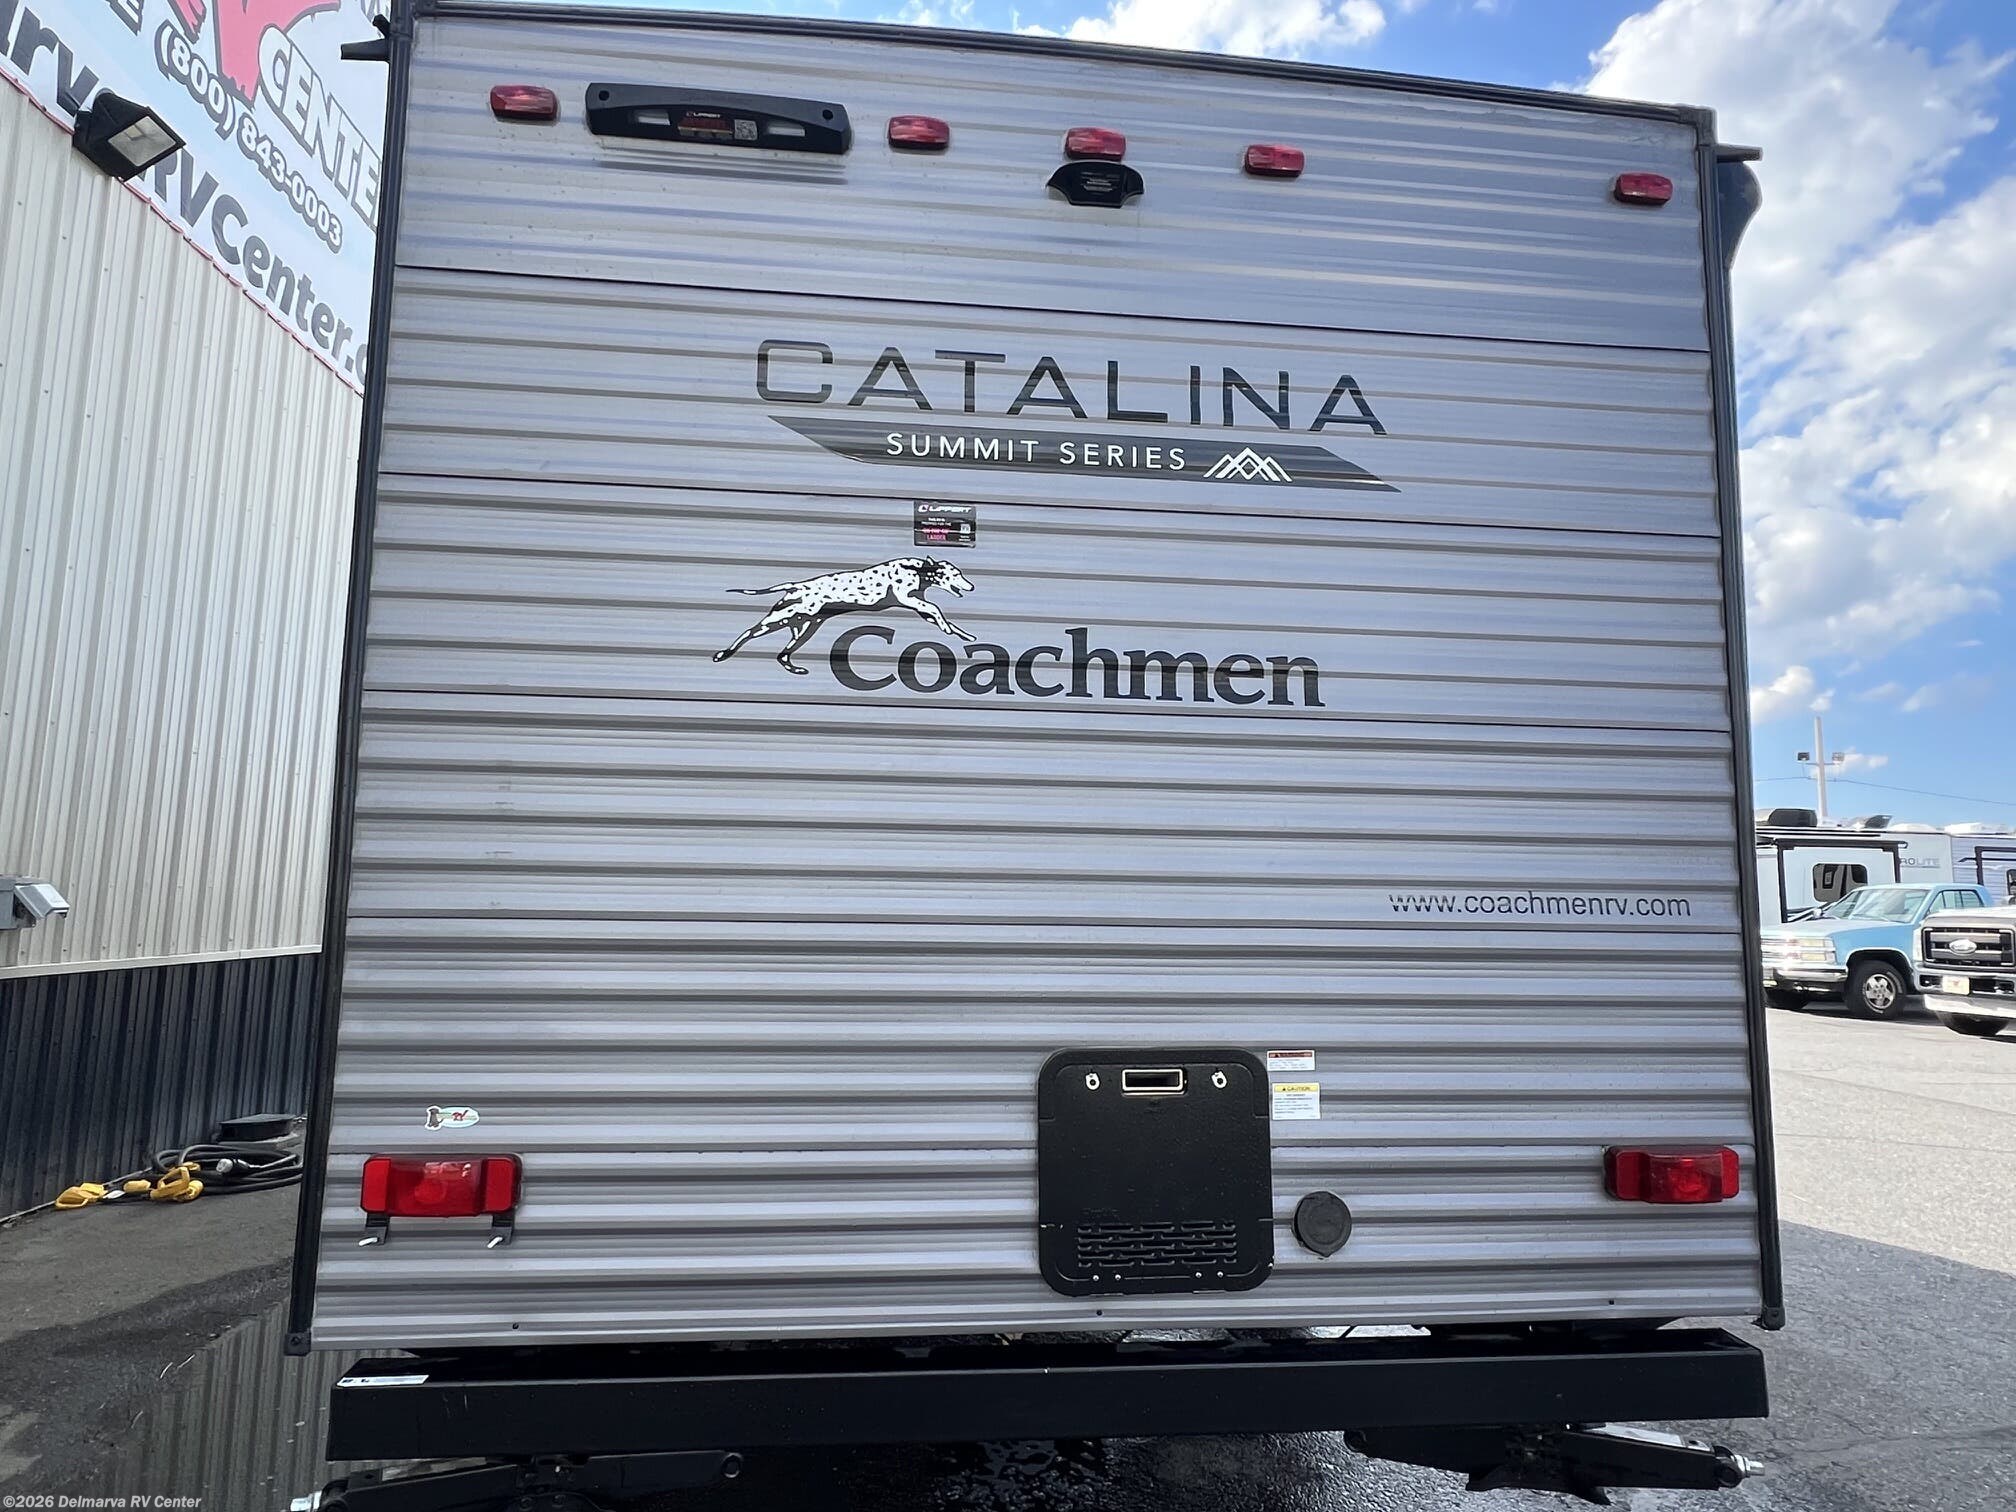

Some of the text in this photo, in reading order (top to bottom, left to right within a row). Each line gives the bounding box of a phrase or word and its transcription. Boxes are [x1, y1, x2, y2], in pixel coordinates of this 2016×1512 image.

[155, 19, 237, 140] (800)
[237, 112, 343, 254] 843-0003
[258, 24, 381, 233] CENTE
[756, 339, 1388, 436] CATALINA
[886, 432, 1186, 471] SUMMIT SERIES
[829, 626, 1326, 707] Coachmen
[1388, 890, 1691, 917] www.coachmenrv.com
